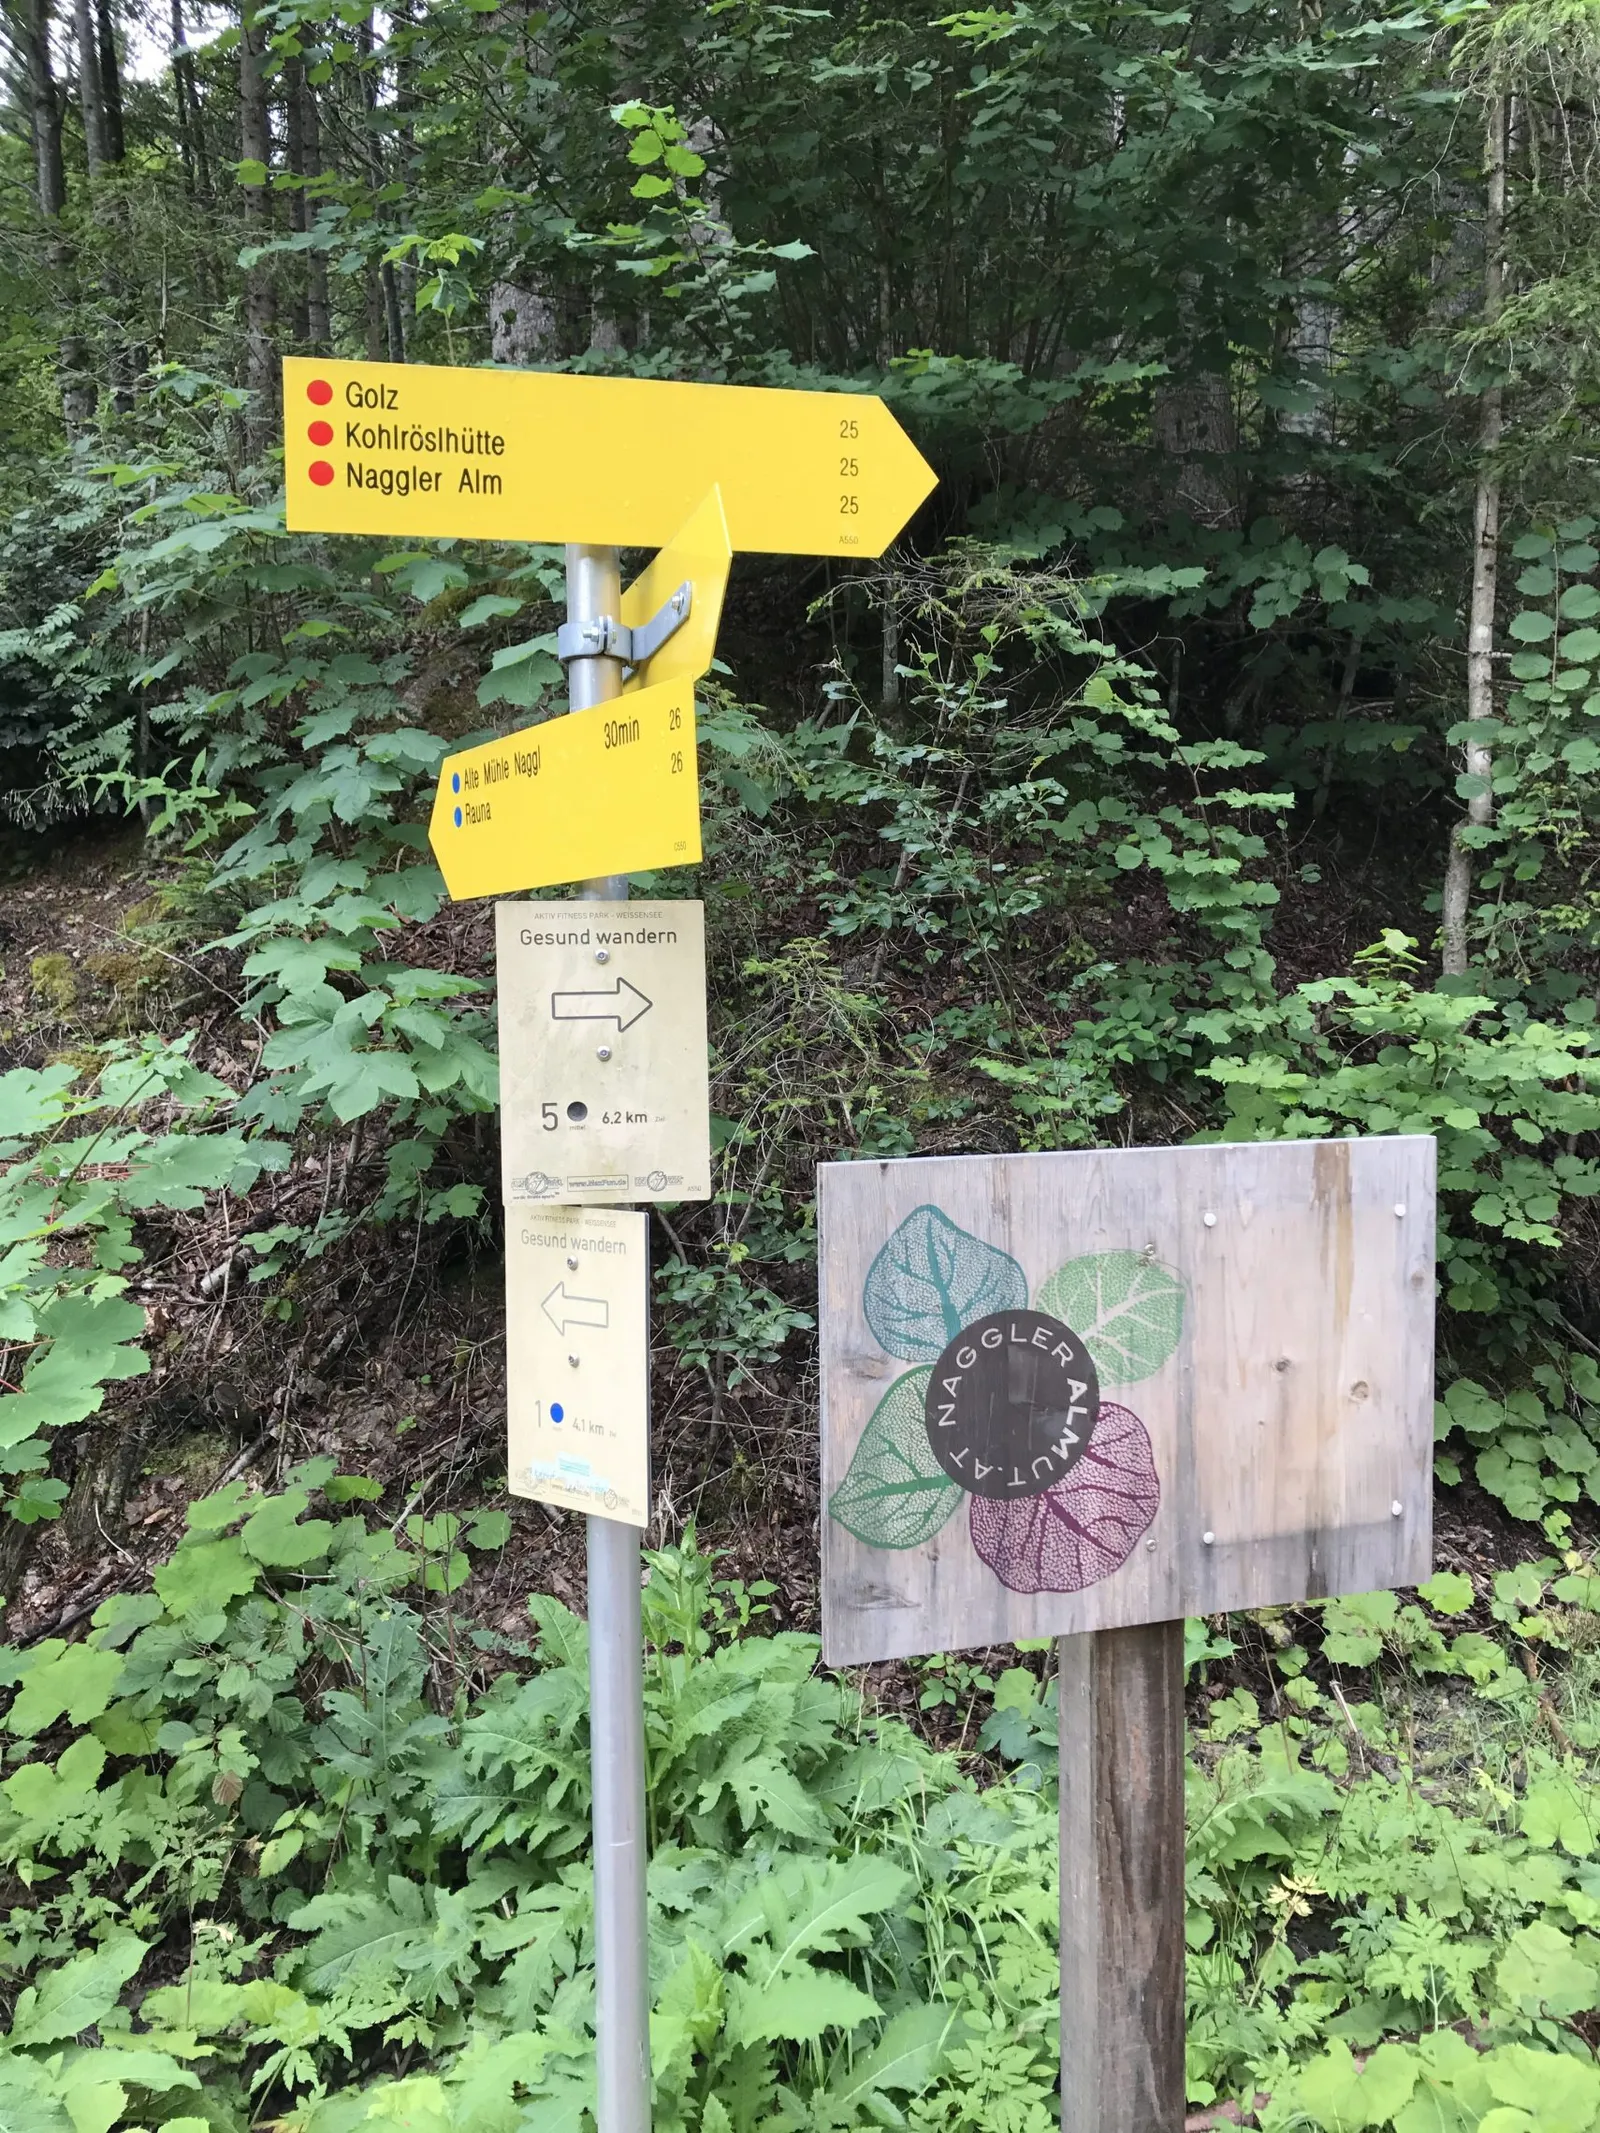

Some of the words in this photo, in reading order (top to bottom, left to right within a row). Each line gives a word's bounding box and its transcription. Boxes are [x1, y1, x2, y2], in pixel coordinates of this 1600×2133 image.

[346, 381, 399, 410] Golz
[839, 420, 859, 439] 25
[346, 422, 505, 456] Kohlröslhütte
[839, 457, 859, 477] 25
[347, 462, 442, 496] Naggler
[458, 468, 502, 495] Alm
[839, 495, 859, 514] 25
[464, 765, 479, 791] Alte
[484, 758, 509, 785] Mühle
[514, 745, 541, 779] Naggl
[604, 716, 640, 750] 30min
[669, 707, 681, 731] 26
[465, 801, 492, 825] Rauna
[671, 751, 683, 774] 26
[520, 928, 590, 945] Gesund
[596, 928, 677, 945] wandern
[534, 912, 556, 920] AKTIV
[557, 912, 588, 920] FITNESS
[616, 911, 663, 919] WEISSENSEE
[541, 1102, 559, 1132] 5
[602, 1111, 622, 1125] 6.2
[626, 1111, 648, 1124] km
[521, 1228, 567, 1249] Gesund
[571, 1236, 627, 1254] wandern
[937, 1323, 1074, 1427] NAGGLER
[535, 1400, 542, 1428] 1
[589, 1420, 604, 1436] km
